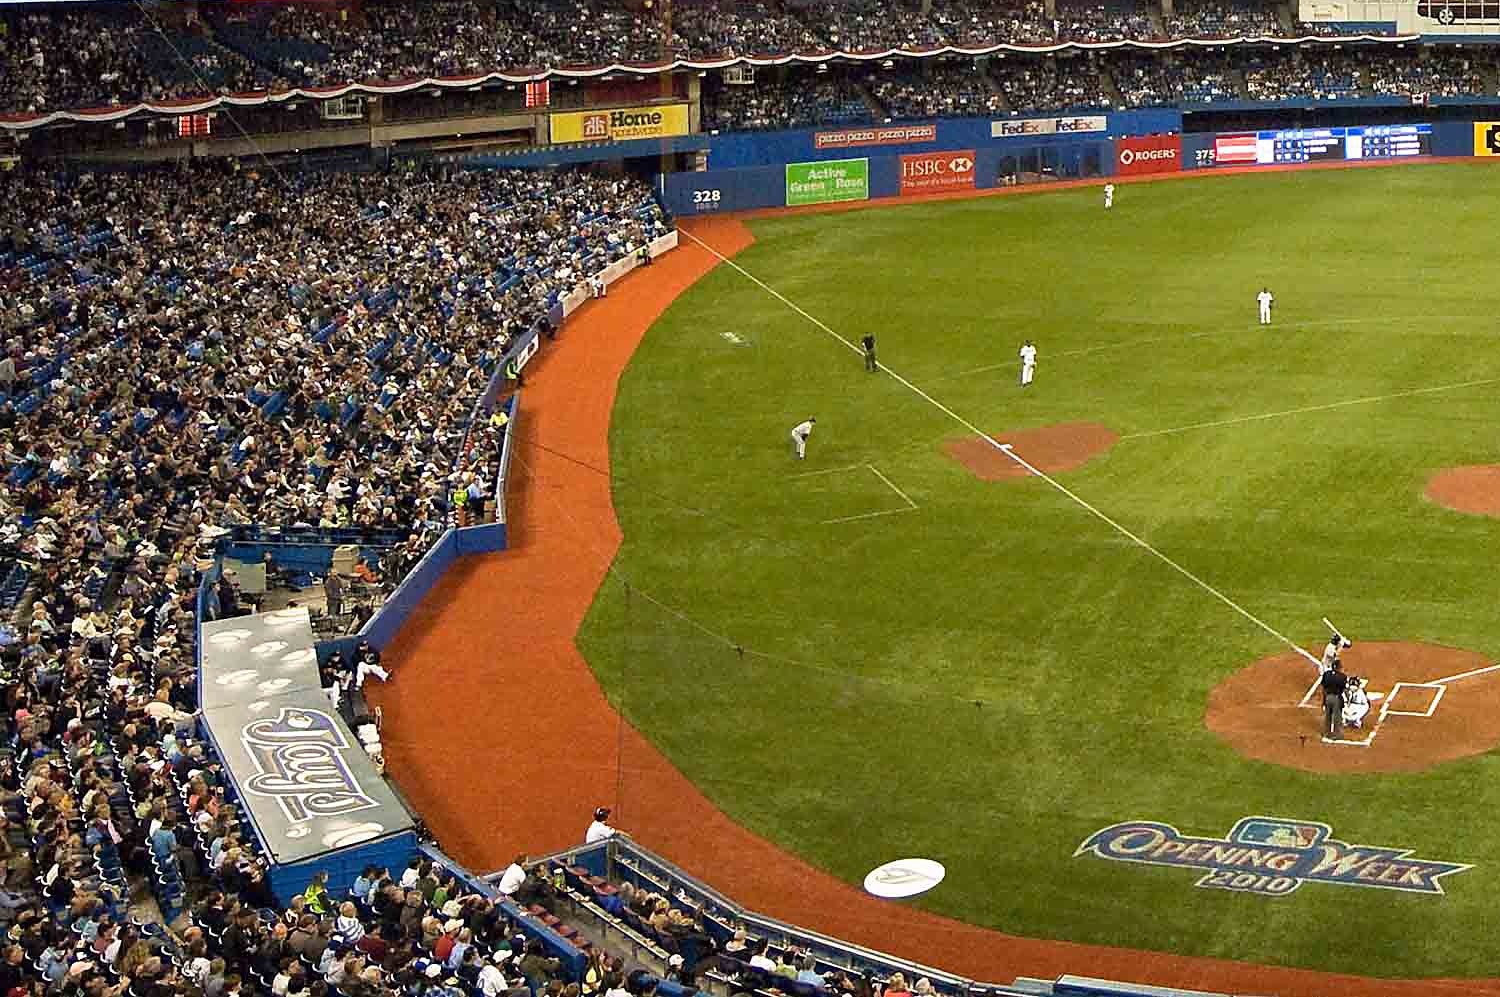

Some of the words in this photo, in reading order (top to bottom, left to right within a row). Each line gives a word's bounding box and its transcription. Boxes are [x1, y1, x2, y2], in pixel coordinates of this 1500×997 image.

[610, 110, 662, 127] Home
[1056, 119, 1095, 131] FedEx
[818, 134, 846, 145] pizza
[847, 132, 874, 144] pizza
[878, 130, 905, 142] pizza
[906, 127, 932, 140] pizza
[1001, 122, 1039, 134] FedEx
[1136, 148, 1176, 161] ROGERS
[1195, 149, 1215, 160] 375
[903, 160, 946, 176] HSBC
[693, 190, 721, 203] 328
[241, 707, 382, 824] Jays
[1110, 826, 1300, 872] OPENING
[1312, 844, 1439, 886] WEEK
[1208, 870, 1293, 893] 2010
